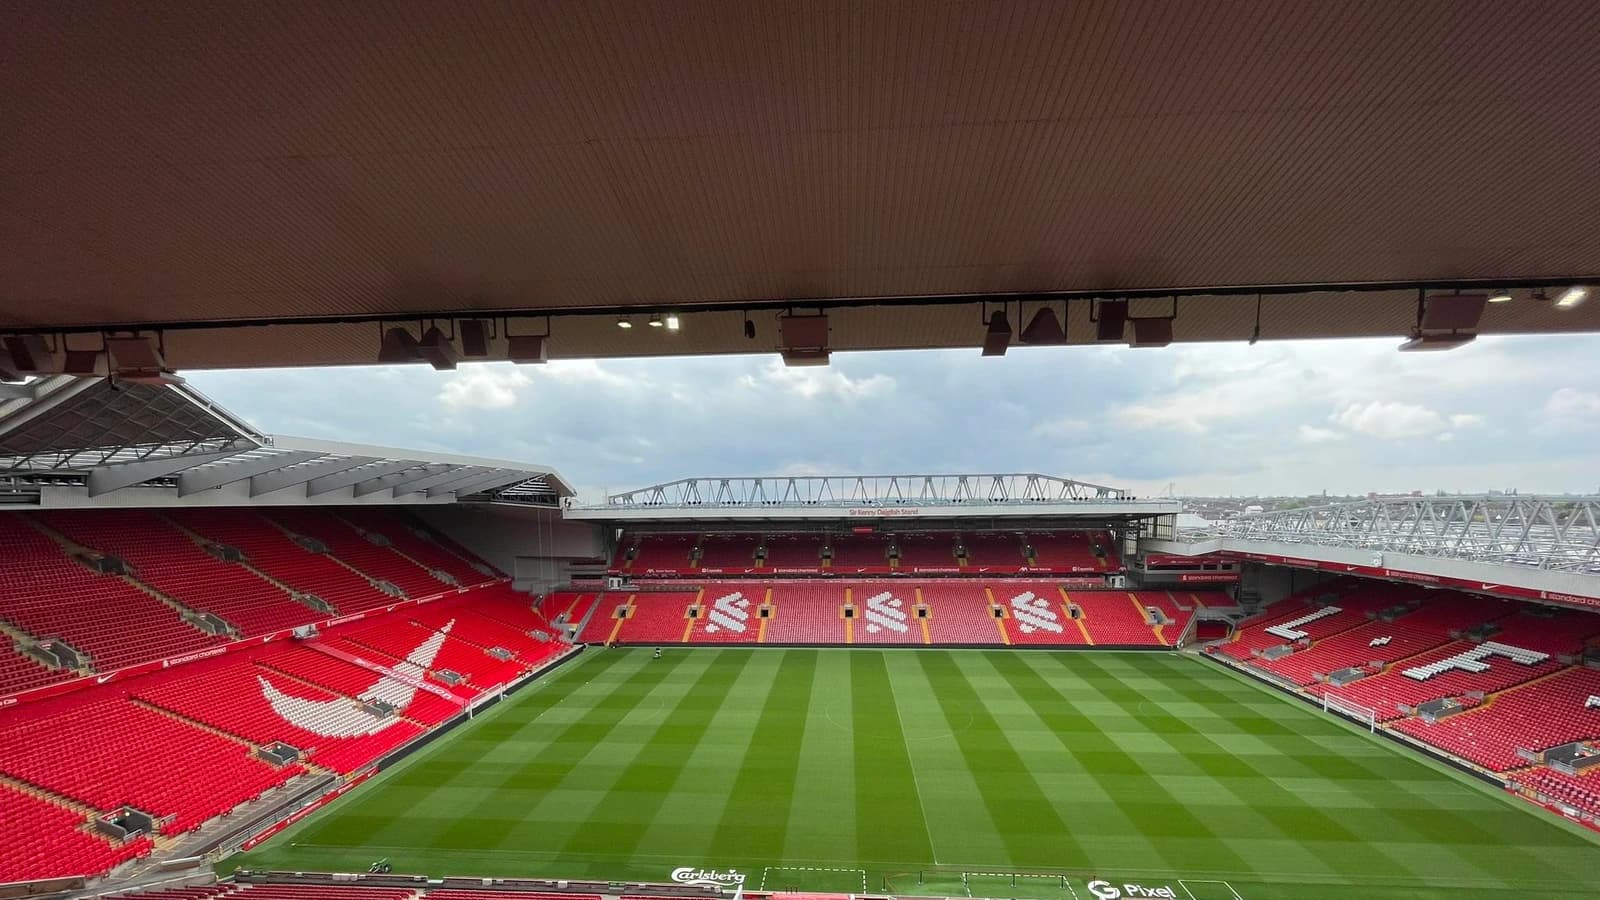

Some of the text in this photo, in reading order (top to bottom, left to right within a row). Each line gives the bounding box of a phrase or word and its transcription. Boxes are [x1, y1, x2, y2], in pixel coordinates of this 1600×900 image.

[1548, 592, 1586, 604] standard
[170, 655, 199, 666] standard
[374, 665, 453, 700] Foundation
[671, 867, 746, 886] Carlsberg
[1123, 884, 1177, 899] Pixel
